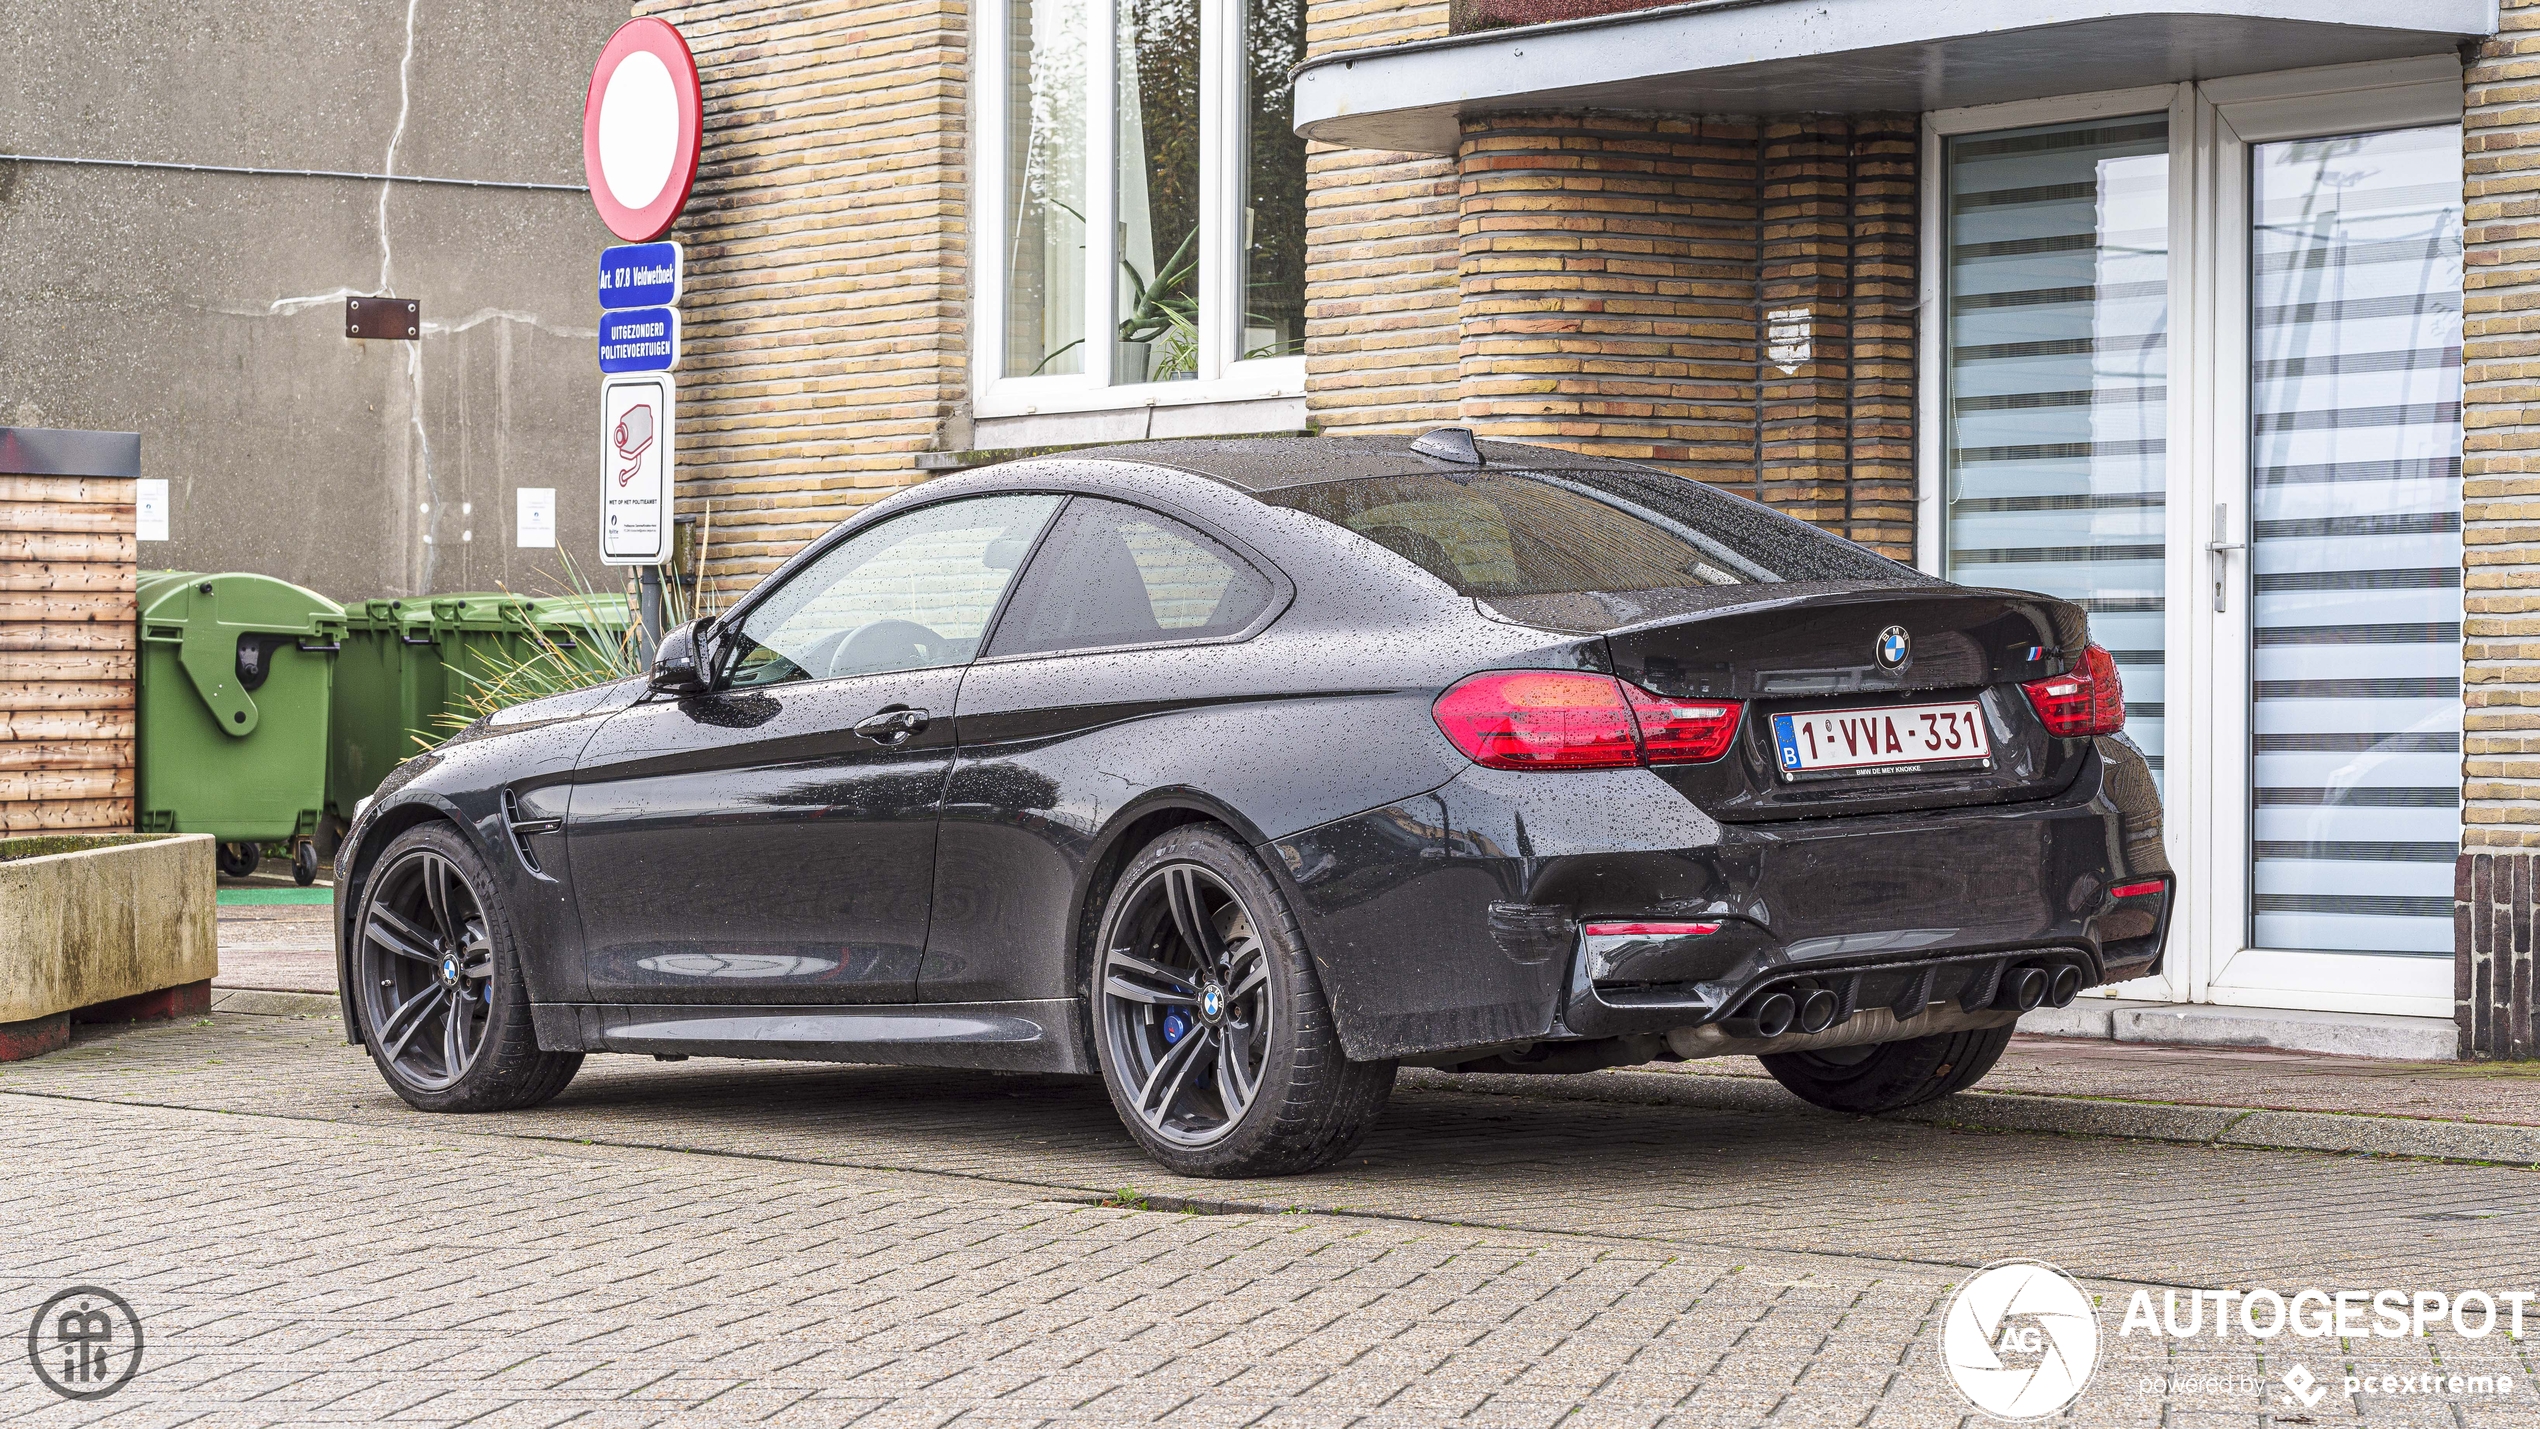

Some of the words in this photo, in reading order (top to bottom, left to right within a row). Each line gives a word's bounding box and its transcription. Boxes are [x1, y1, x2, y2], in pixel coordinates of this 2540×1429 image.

[600, 270, 612, 289] Art.
[615, 267, 631, 288] 87.8
[633, 263, 674, 286] Veldwetboek
[611, 322, 665, 340] UITGEZONDERD
[601, 340, 671, 360] POLITIEVOERTUIGEN
[1881, 627, 1909, 642] BMW
[1802, 711, 1979, 760] 1-VVA-331
[1783, 747, 1798, 766] B
[1856, 764, 1871, 776] BMW
[1872, 763, 1881, 775] DE
[1881, 762, 1895, 774] MEY
[1895, 760, 1922, 773] KNOKKE
